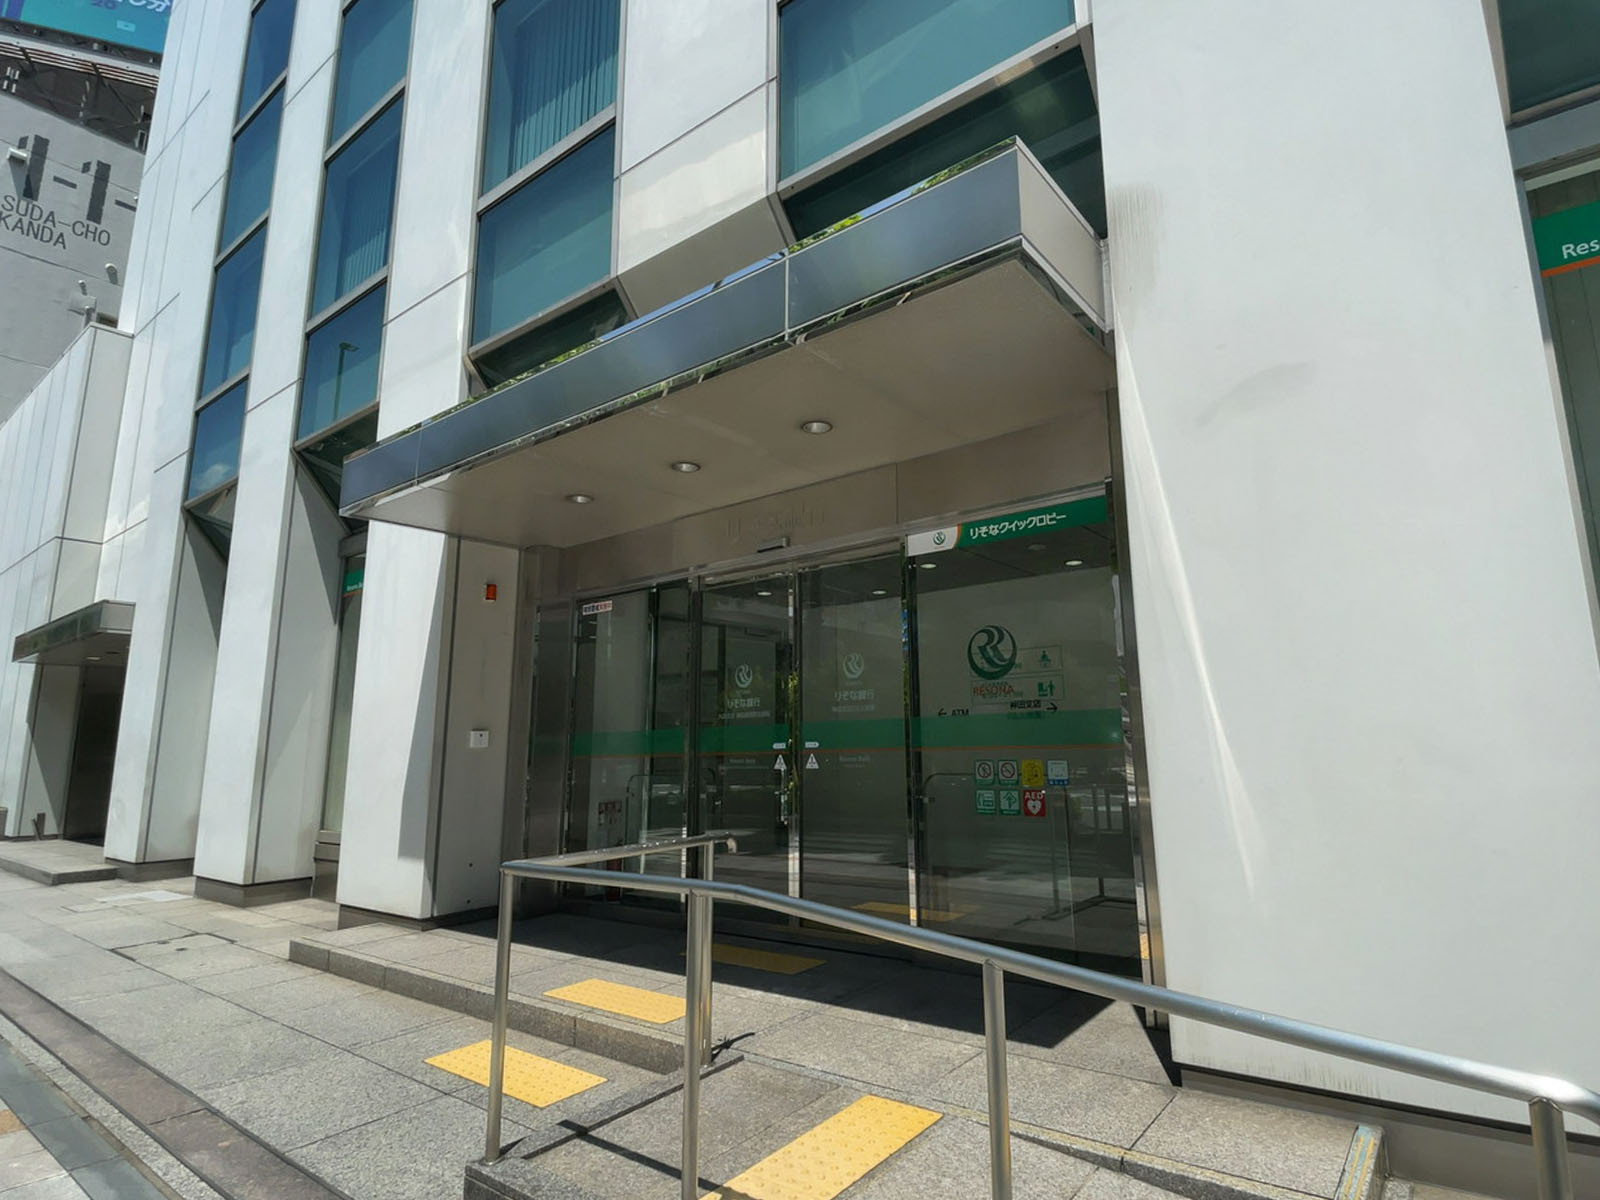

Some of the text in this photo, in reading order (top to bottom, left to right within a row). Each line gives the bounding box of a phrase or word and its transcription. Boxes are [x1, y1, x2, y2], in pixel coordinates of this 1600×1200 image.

[0, 211, 67, 250] KANDA
[2, 194, 111, 246] SUDA-CHO
[1562, 239, 1600, 259] Res
[969, 512, 1067, 540] りそなクイックロビー
[951, 708, 970, 718] ATM
[1024, 791, 1044, 800] AED
